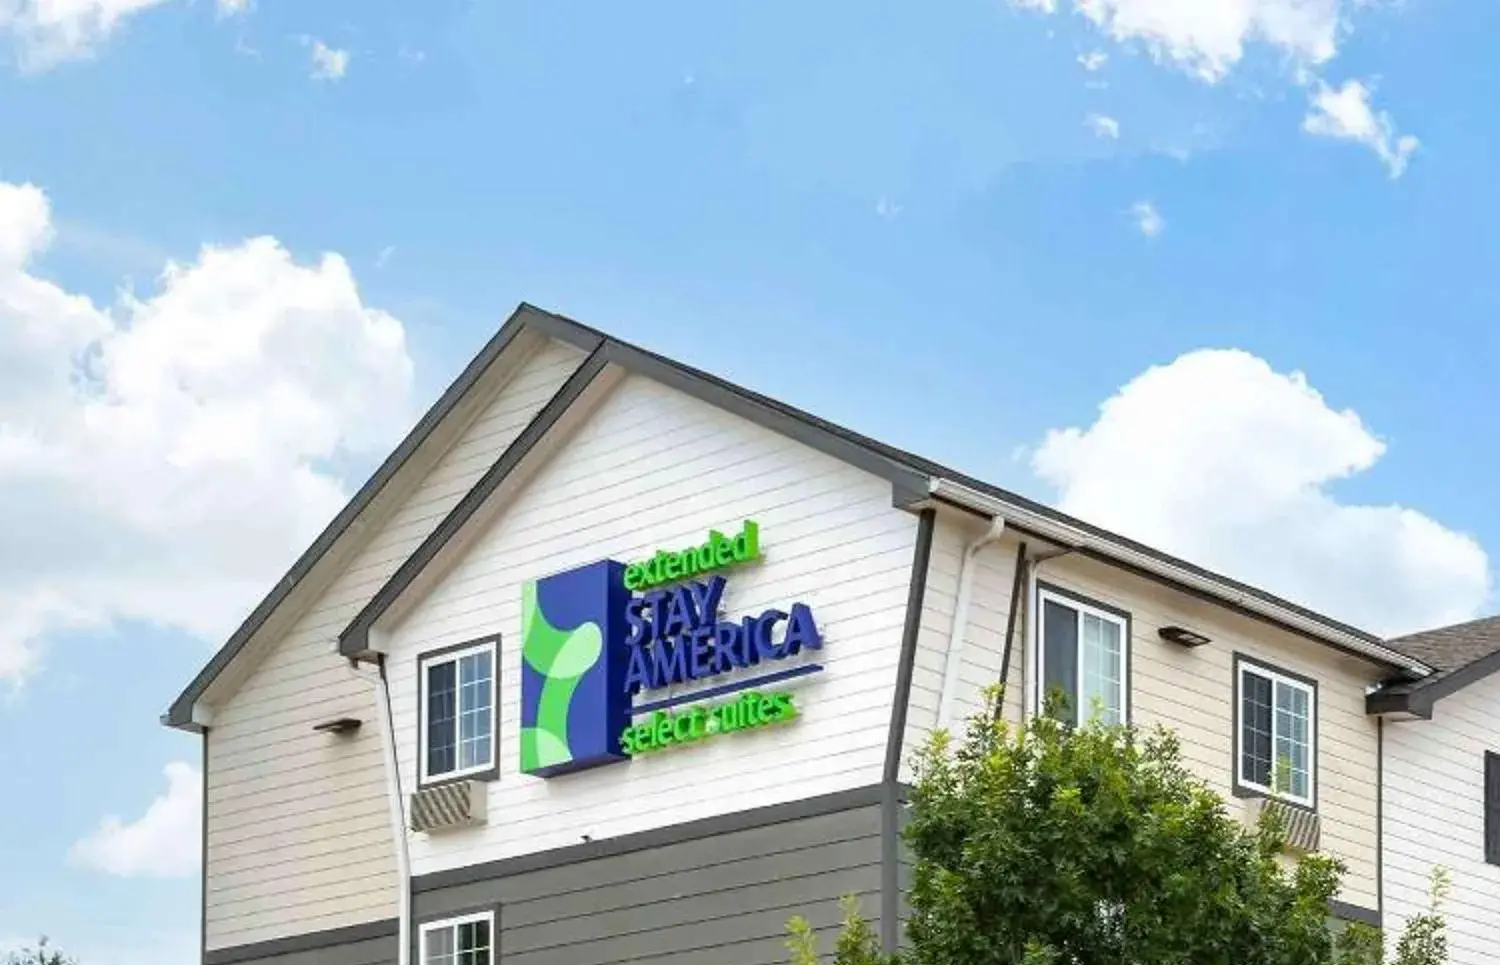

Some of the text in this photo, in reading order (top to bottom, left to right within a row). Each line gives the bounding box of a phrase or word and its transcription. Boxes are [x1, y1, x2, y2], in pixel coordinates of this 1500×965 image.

[624, 519, 759, 590] extended
[624, 575, 727, 646] STAY
[624, 602, 824, 696] AMERICA
[621, 691, 798, 755] select suites
